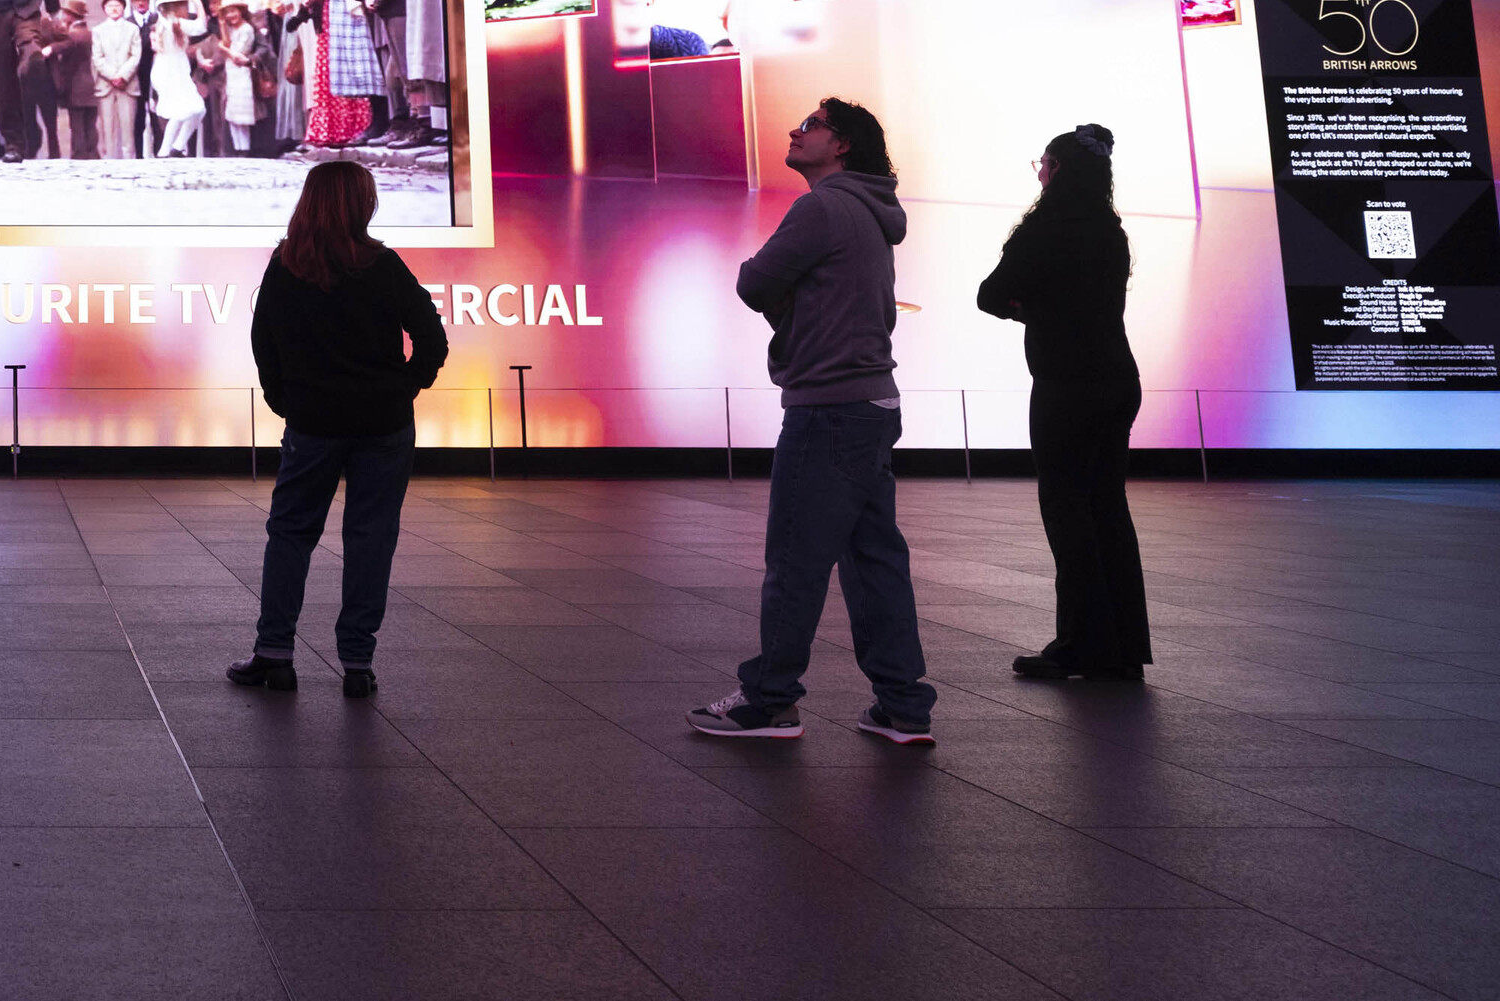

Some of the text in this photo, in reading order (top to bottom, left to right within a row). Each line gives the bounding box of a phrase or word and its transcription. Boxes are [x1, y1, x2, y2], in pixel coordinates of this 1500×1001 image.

[1322, 60, 1418, 70] BRITISH ARROWS
[1355, 88, 1392, 96] celebrating
[1429, 88, 1464, 96] honouring
[1356, 97, 1394, 105] advertising.
[1368, 115, 1406, 123] recognising
[1422, 115, 1466, 123] extraordinary
[1287, 124, 1325, 132] storytelling
[1386, 124, 1411, 132] moving
[1411, 124, 1431, 132] image
[1431, 124, 1468, 132] advertising
[1354, 133, 1383, 141] powerful
[1409, 133, 1436, 141] exports.
[1361, 151, 1384, 159] golden
[1456, 151, 1471, 159] only
[1291, 160, 1316, 168] looking
[1391, 160, 1415, 168] shaped
[1292, 169, 1318, 178] inviting
[1429, 169, 1450, 178] today.
[170, 283, 237, 324] TV
